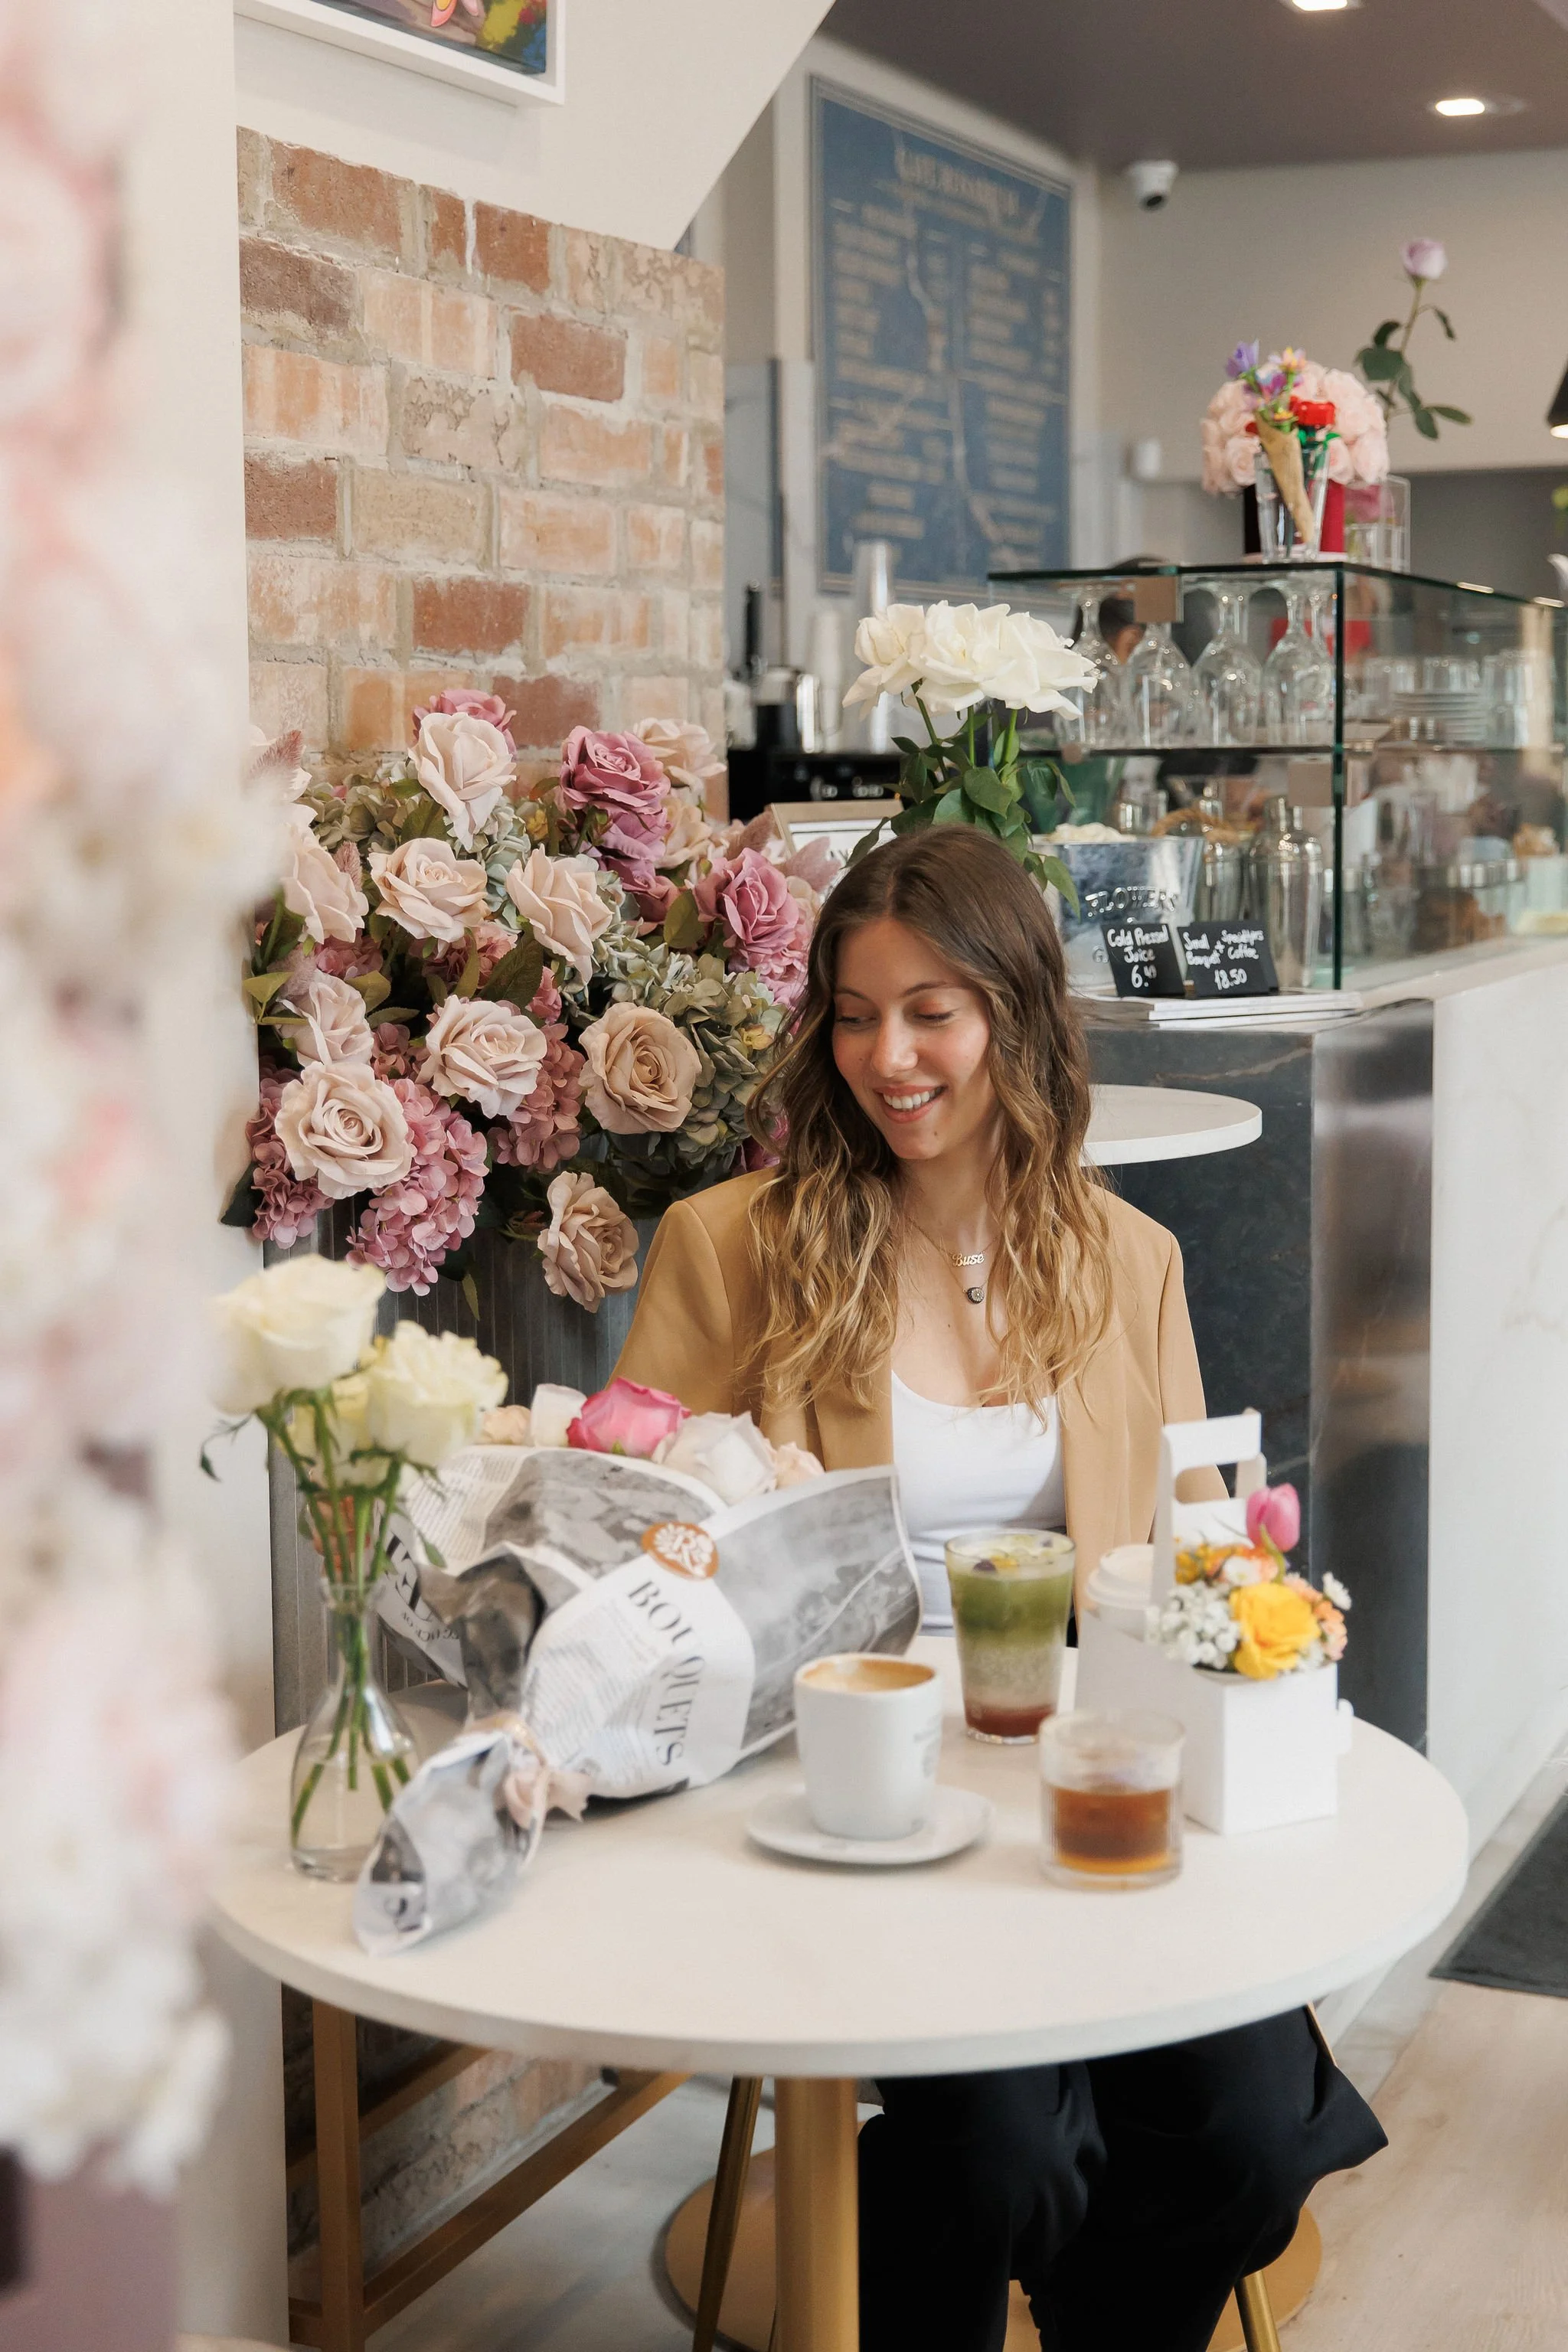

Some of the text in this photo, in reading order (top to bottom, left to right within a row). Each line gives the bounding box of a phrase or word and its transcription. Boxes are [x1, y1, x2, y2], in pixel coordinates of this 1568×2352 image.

[1107, 928, 1134, 947] Cold
[1124, 946, 1155, 963] Juice
[1227, 943, 1259, 960] Coffee
[1214, 968, 1247, 990] 18.50
[951, 1253, 985, 1267] Buse
[628, 1579, 707, 1766] BOUQUETS
